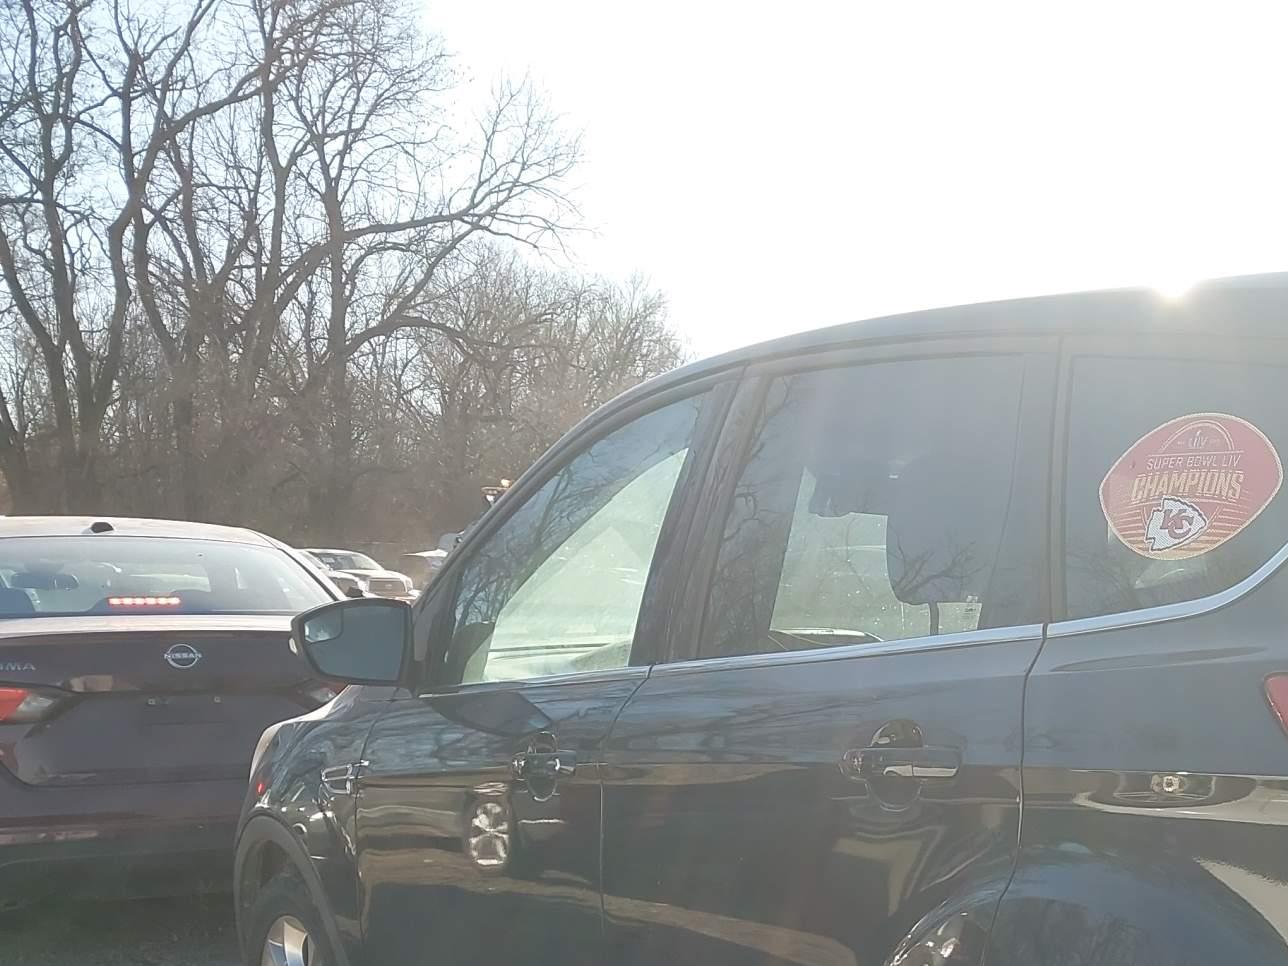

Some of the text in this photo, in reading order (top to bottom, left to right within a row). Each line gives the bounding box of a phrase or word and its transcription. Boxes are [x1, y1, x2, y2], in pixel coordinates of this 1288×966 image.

[1146, 454, 1241, 471] SUPER BOWL LIV
[1131, 470, 1244, 501] CHAMPIONS
[1160, 509, 1194, 540] KC
